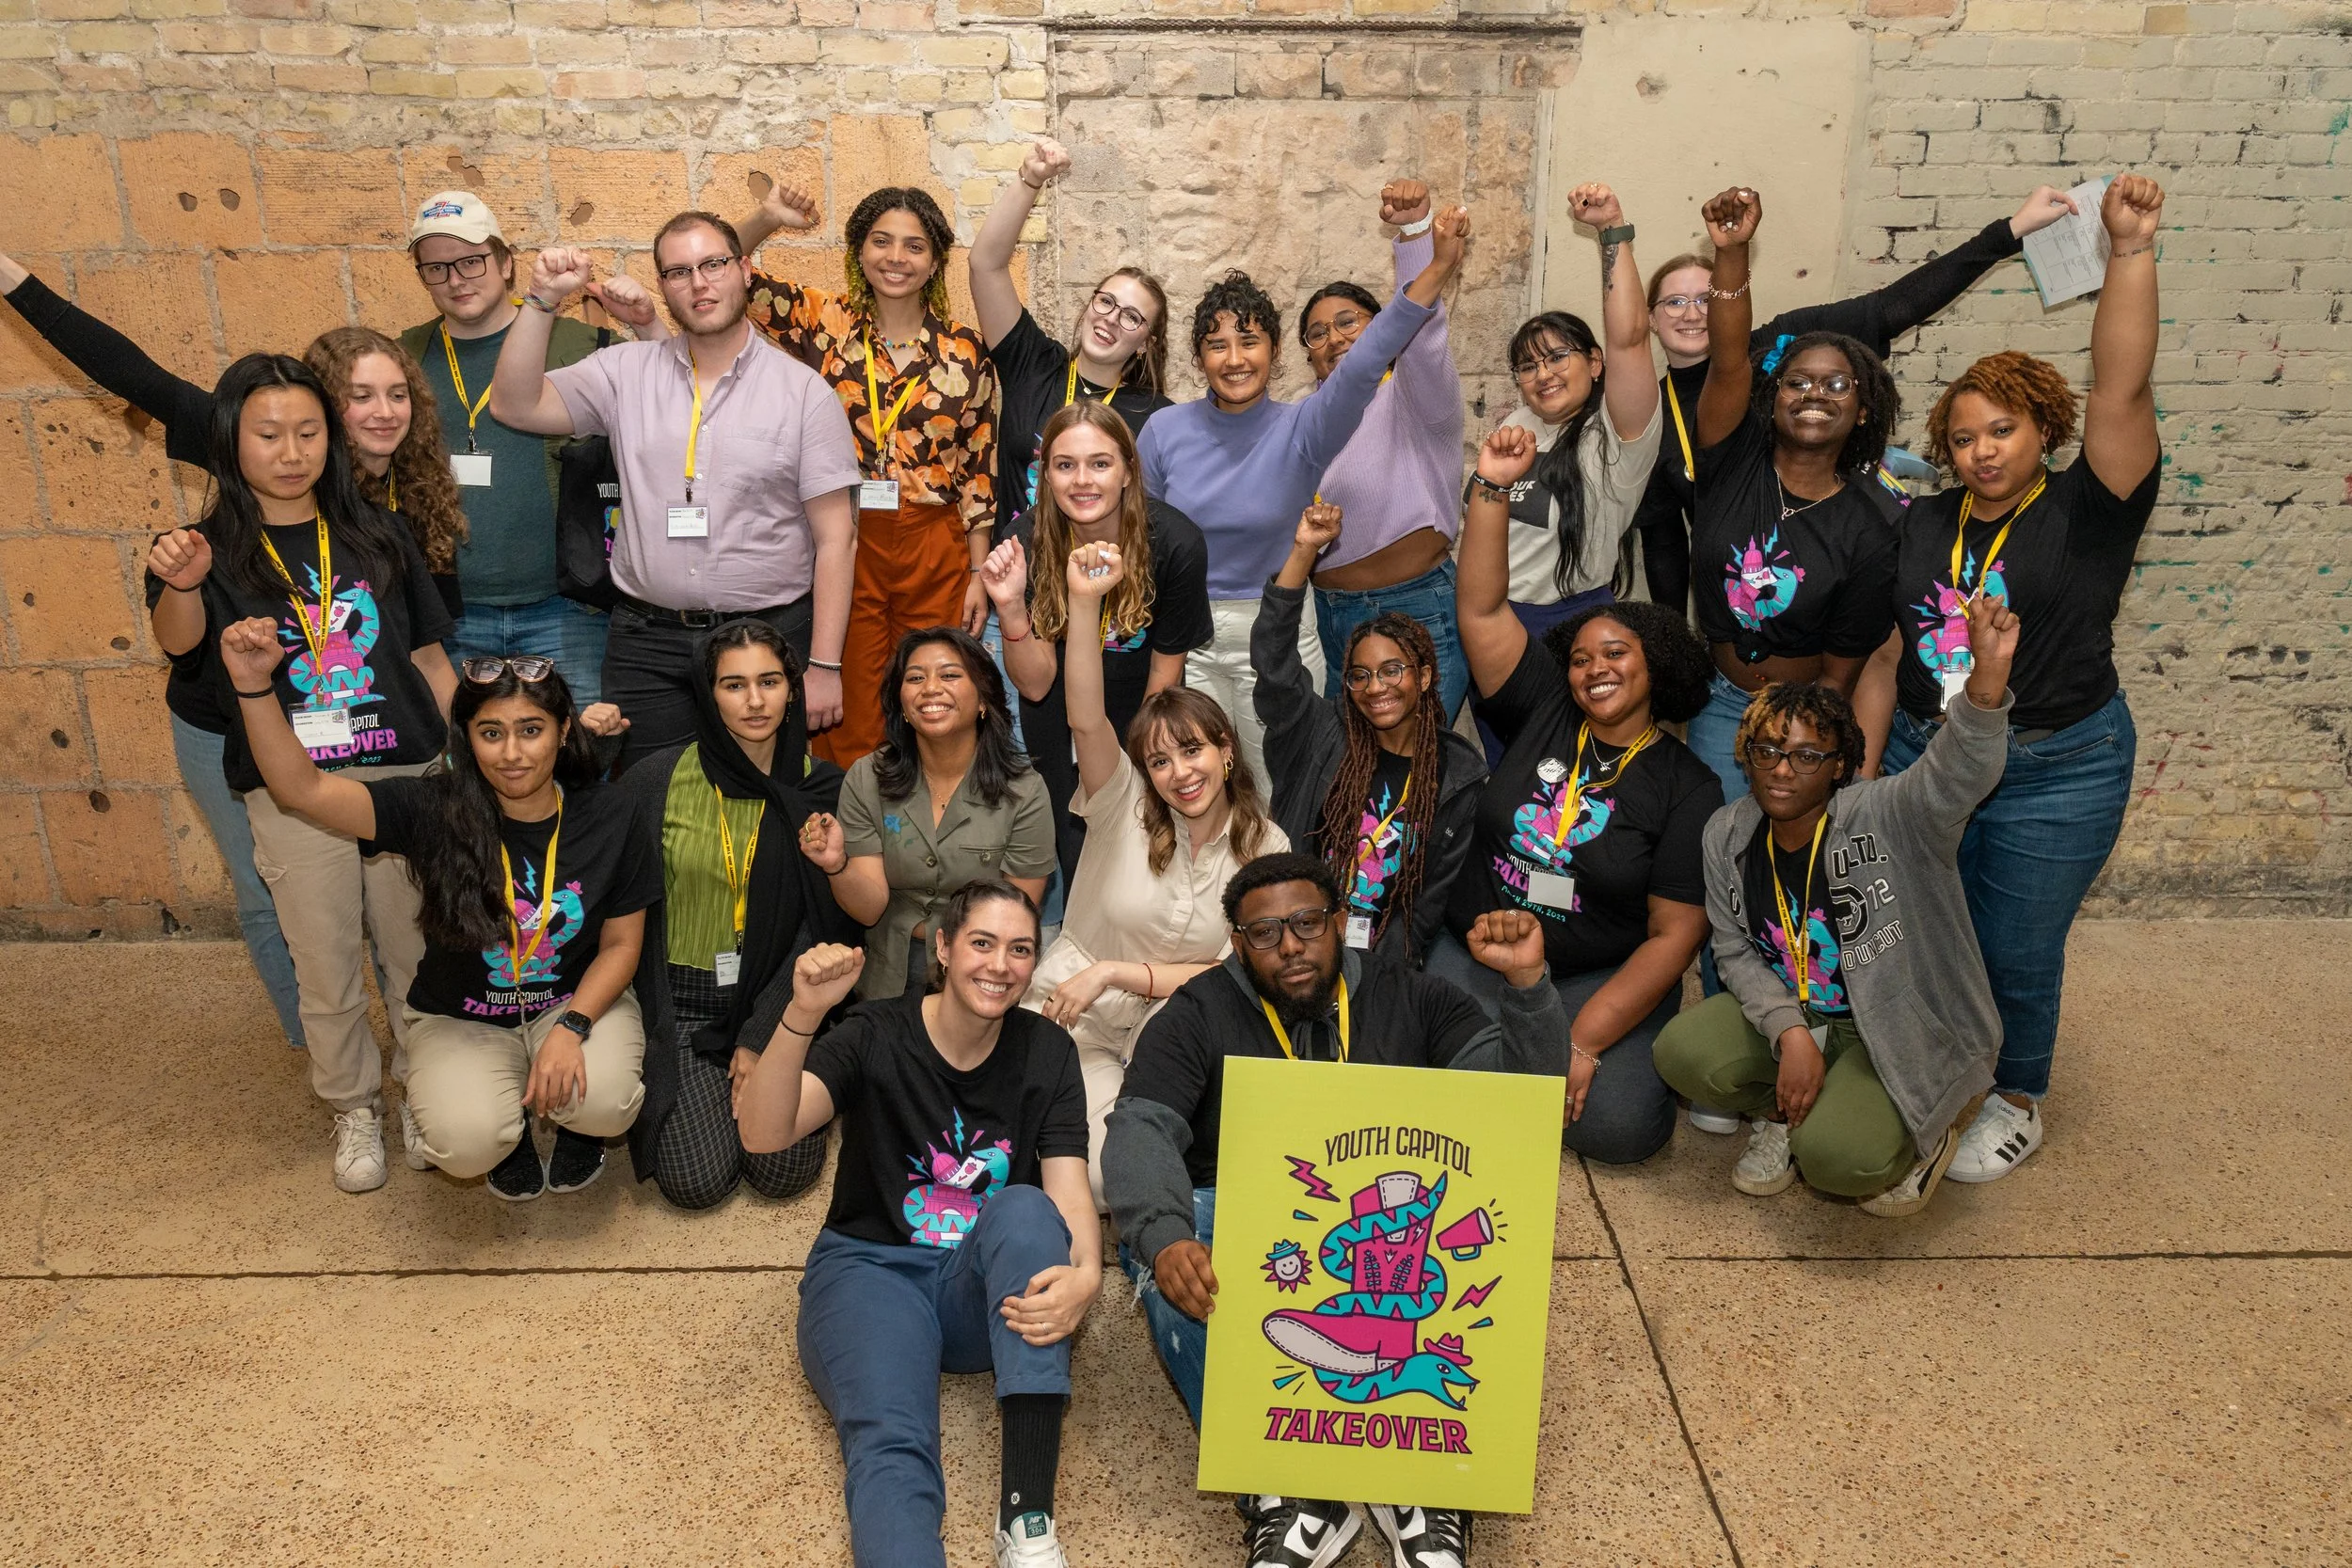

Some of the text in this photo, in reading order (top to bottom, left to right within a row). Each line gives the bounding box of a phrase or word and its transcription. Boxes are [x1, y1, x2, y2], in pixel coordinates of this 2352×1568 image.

[596, 483, 619, 498] YOUTH
[1784, 918, 1792, 940] MOMENT
[485, 990, 516, 1005] YOUTH
[1325, 1126, 1472, 1178] YOUTH CAPITOL
[1263, 1407, 1473, 1454] TAKEOVER
